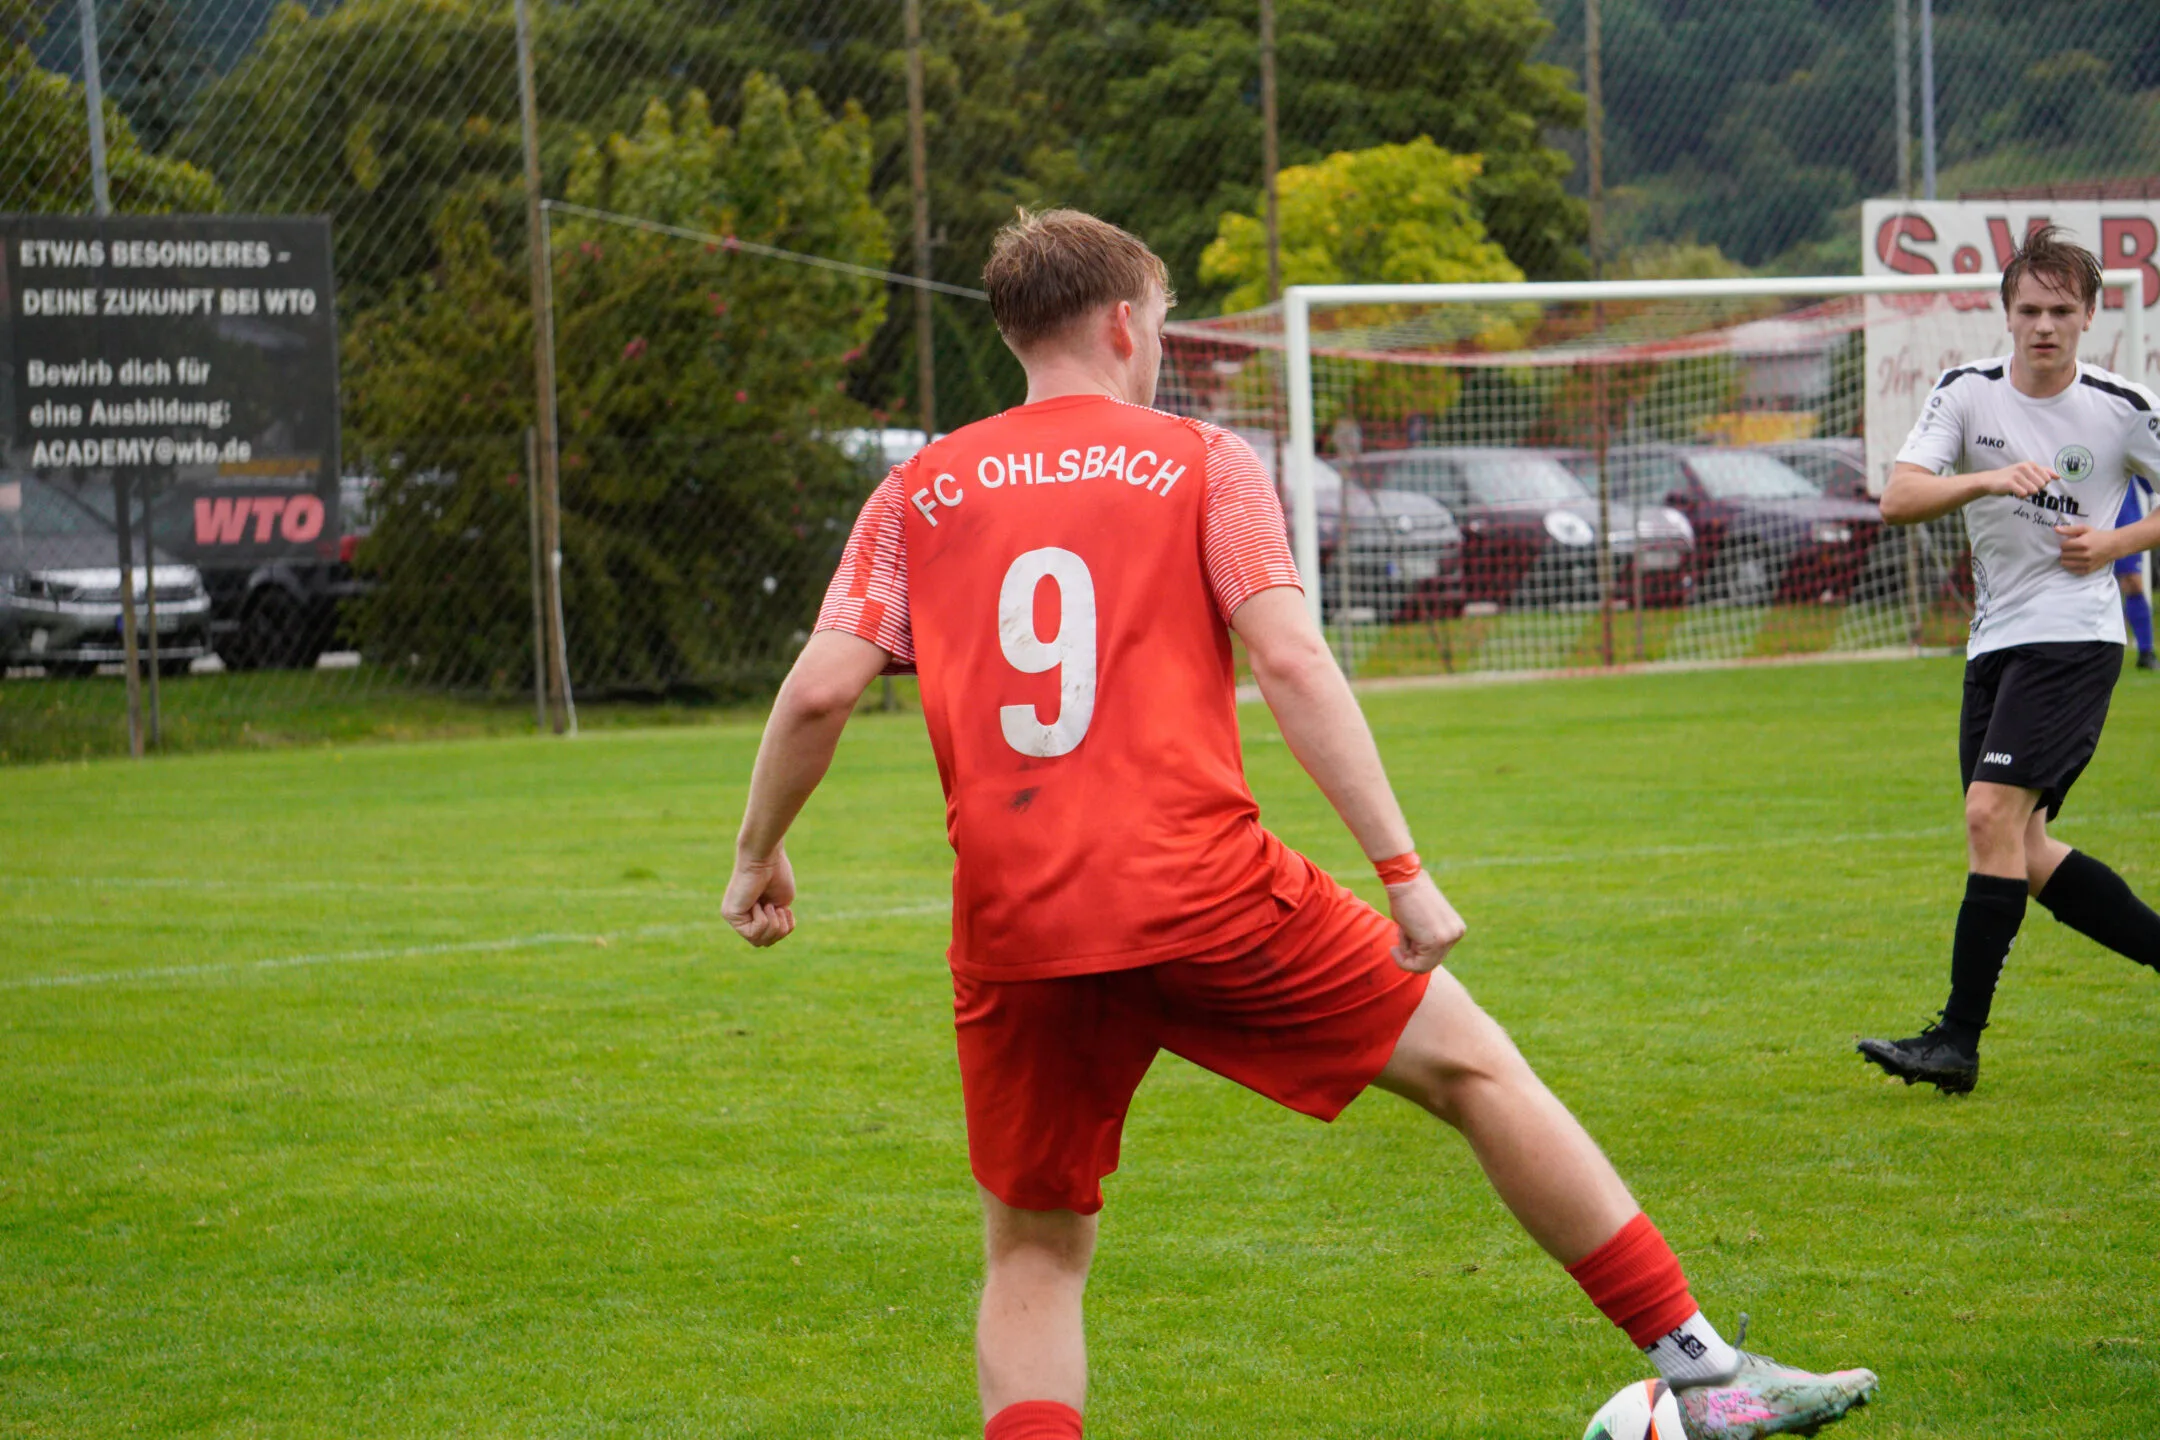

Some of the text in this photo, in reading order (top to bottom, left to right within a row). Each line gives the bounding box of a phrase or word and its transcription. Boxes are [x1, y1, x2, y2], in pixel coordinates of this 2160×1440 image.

[19, 239, 105, 268] ETWAS
[110, 240, 271, 269] BESONDERES
[22, 287, 317, 317] DEINE ZUKUNFT BEI WTO
[27, 356, 211, 387] Bewirb dich für
[29, 398, 231, 429] eine Ausbildung:
[31, 437, 251, 469] ACADEMY@wto.de
[1975, 434, 2006, 450] JAKO
[911, 444, 1187, 528] FC OHLSBACH
[193, 493, 326, 545] WTO
[997, 545, 1098, 759] 9
[1982, 751, 2013, 766] JAKO
